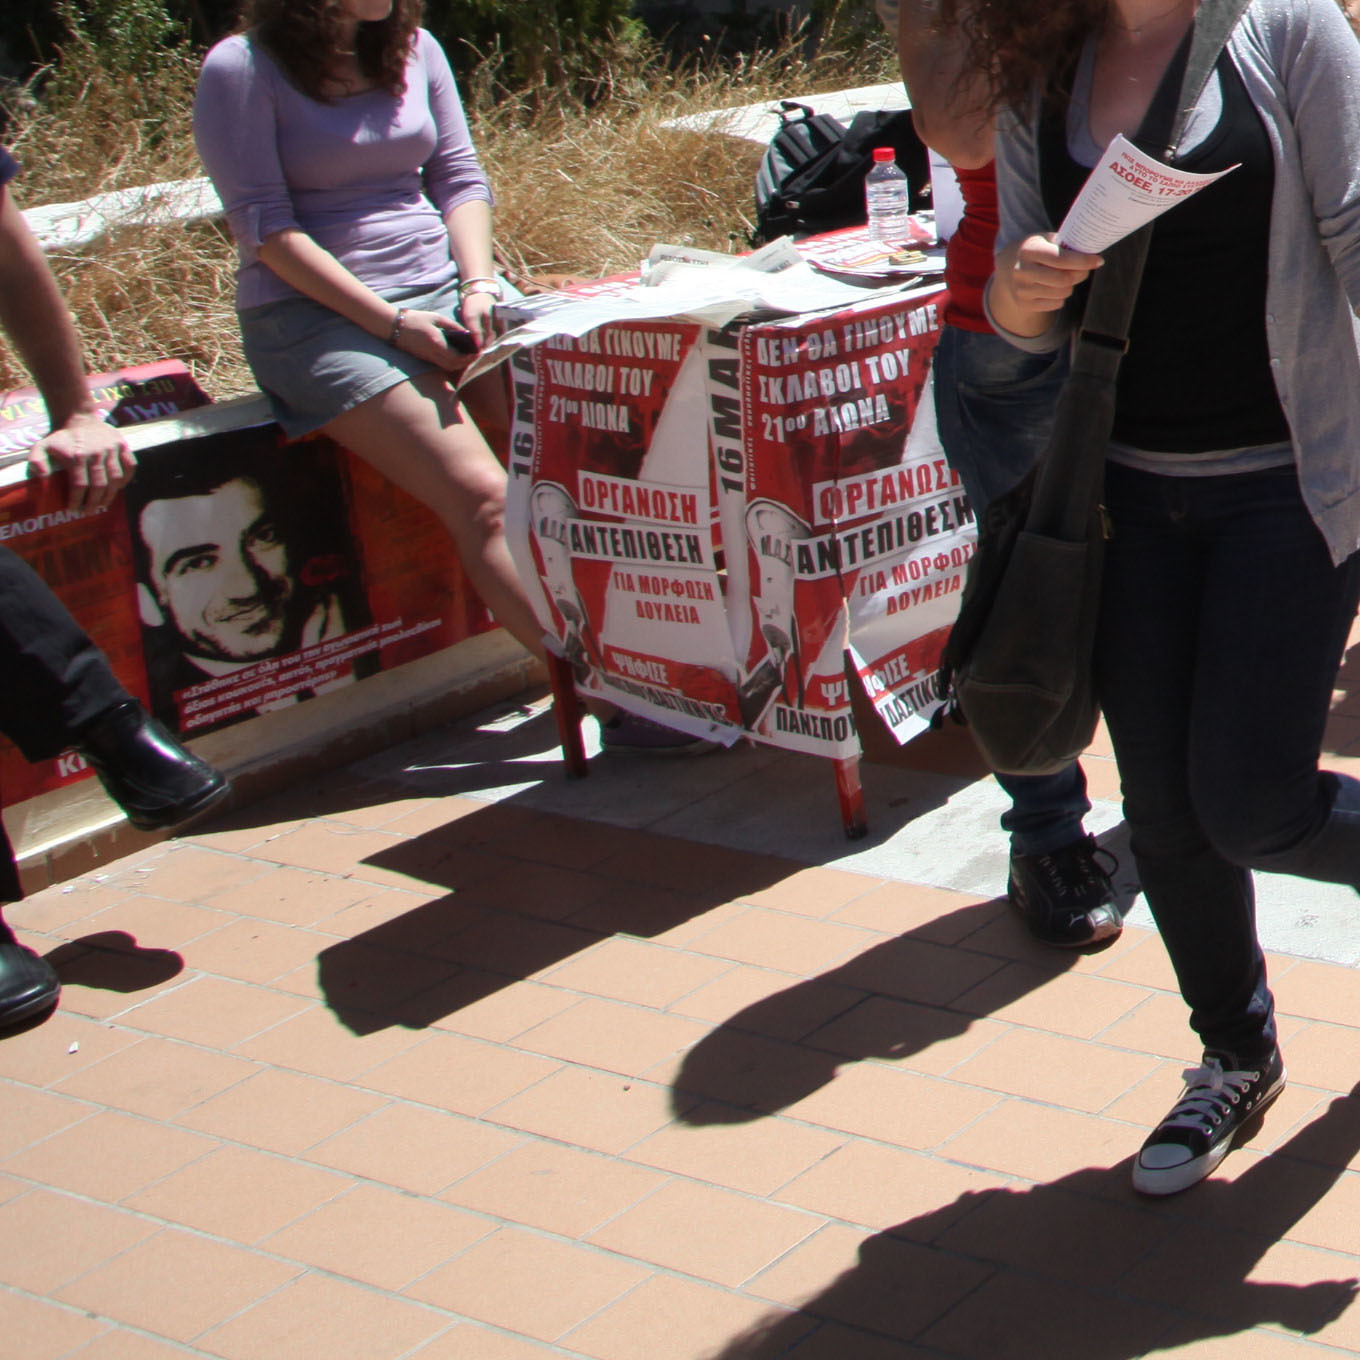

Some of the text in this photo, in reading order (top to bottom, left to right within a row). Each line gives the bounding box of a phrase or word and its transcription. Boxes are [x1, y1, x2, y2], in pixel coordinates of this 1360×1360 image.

[605, 328, 683, 362] ΓΙΝΟΥΜΕ
[757, 303, 940, 367] ΔΕΝ ΘΑ ΓΙΝΟΥΜΕ
[511, 349, 537, 425] ΜΑ
[546, 358, 654, 397] ΣΚΛΑΒΟΙ ΤΟΥ
[758, 348, 911, 406] ΣΚΛΑΒΟΙ ΤΟΥ
[581, 401, 631, 434] ΑΙΩΝΑ
[813, 392, 892, 438] ΑΙΩΝΑ
[716, 445, 746, 497] 16
[582, 477, 699, 525] ΟΡΓΑΝΩΣΗ
[570, 523, 705, 565] ΑΝΤΕΠΙΘΕΣΗ
[797, 493, 976, 575] ΑΝΤΕΠΙΘΕΣΗ
[612, 571, 716, 601] ΓΙΑ ΜΟΡΦΩΣΗ
[859, 569, 888, 597] ΓΙΑ
[886, 575, 961, 617] ΔΟΥΛΕΙΑ
[635, 599, 702, 624] ΔΟΥΛΕΙΑ
